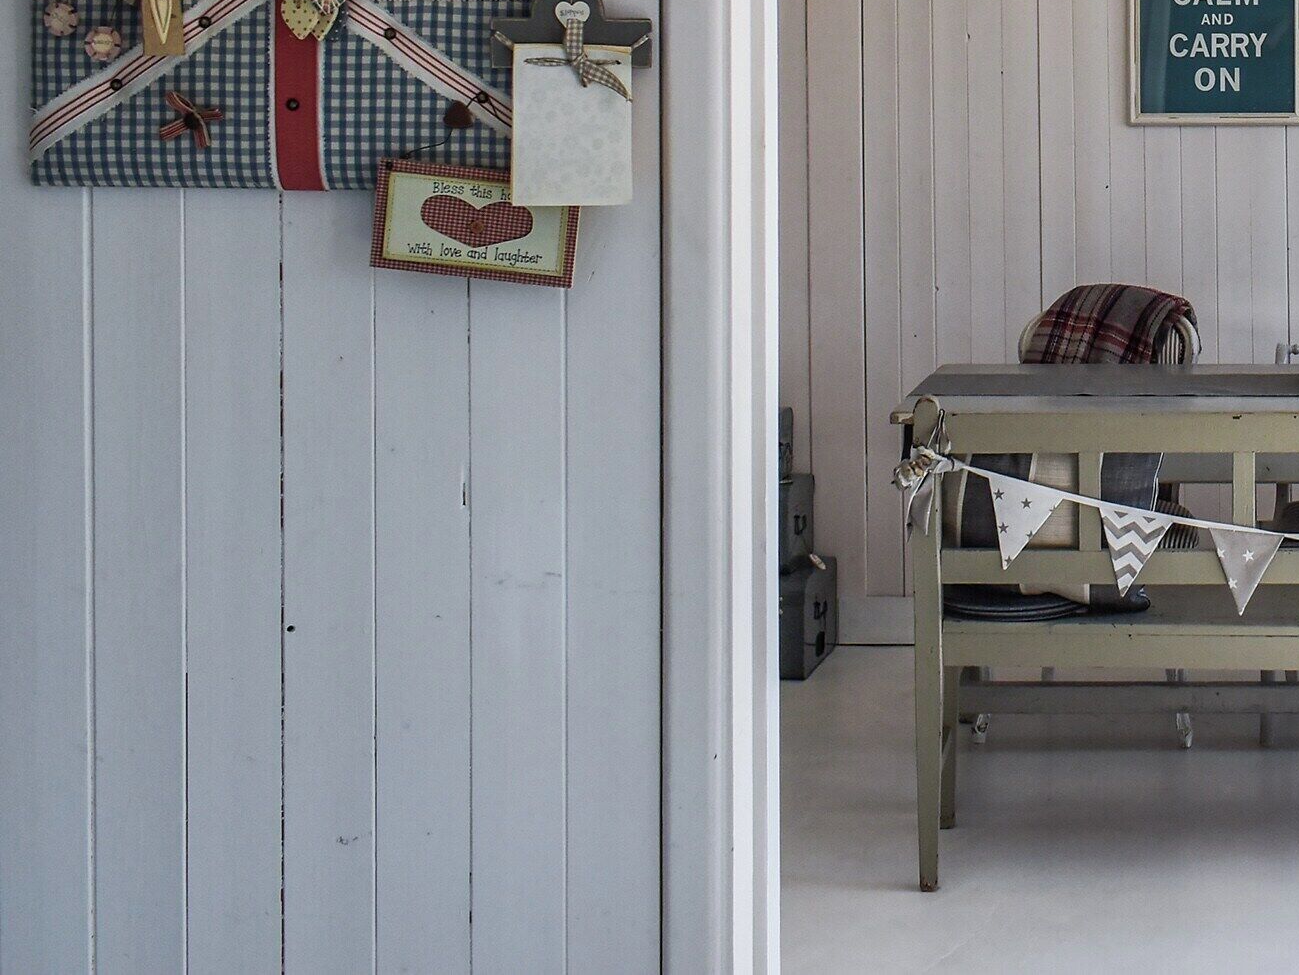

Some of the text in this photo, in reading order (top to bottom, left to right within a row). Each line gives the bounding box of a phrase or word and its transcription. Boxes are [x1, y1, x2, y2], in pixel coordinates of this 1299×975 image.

[1200, 13, 1234, 26] AND
[1169, 32, 1268, 58] CARRY
[1194, 67, 1241, 93] ON
[432, 181, 465, 195] Bless
[469, 184, 493, 200] this
[407, 242, 543, 267] with love and laughter
